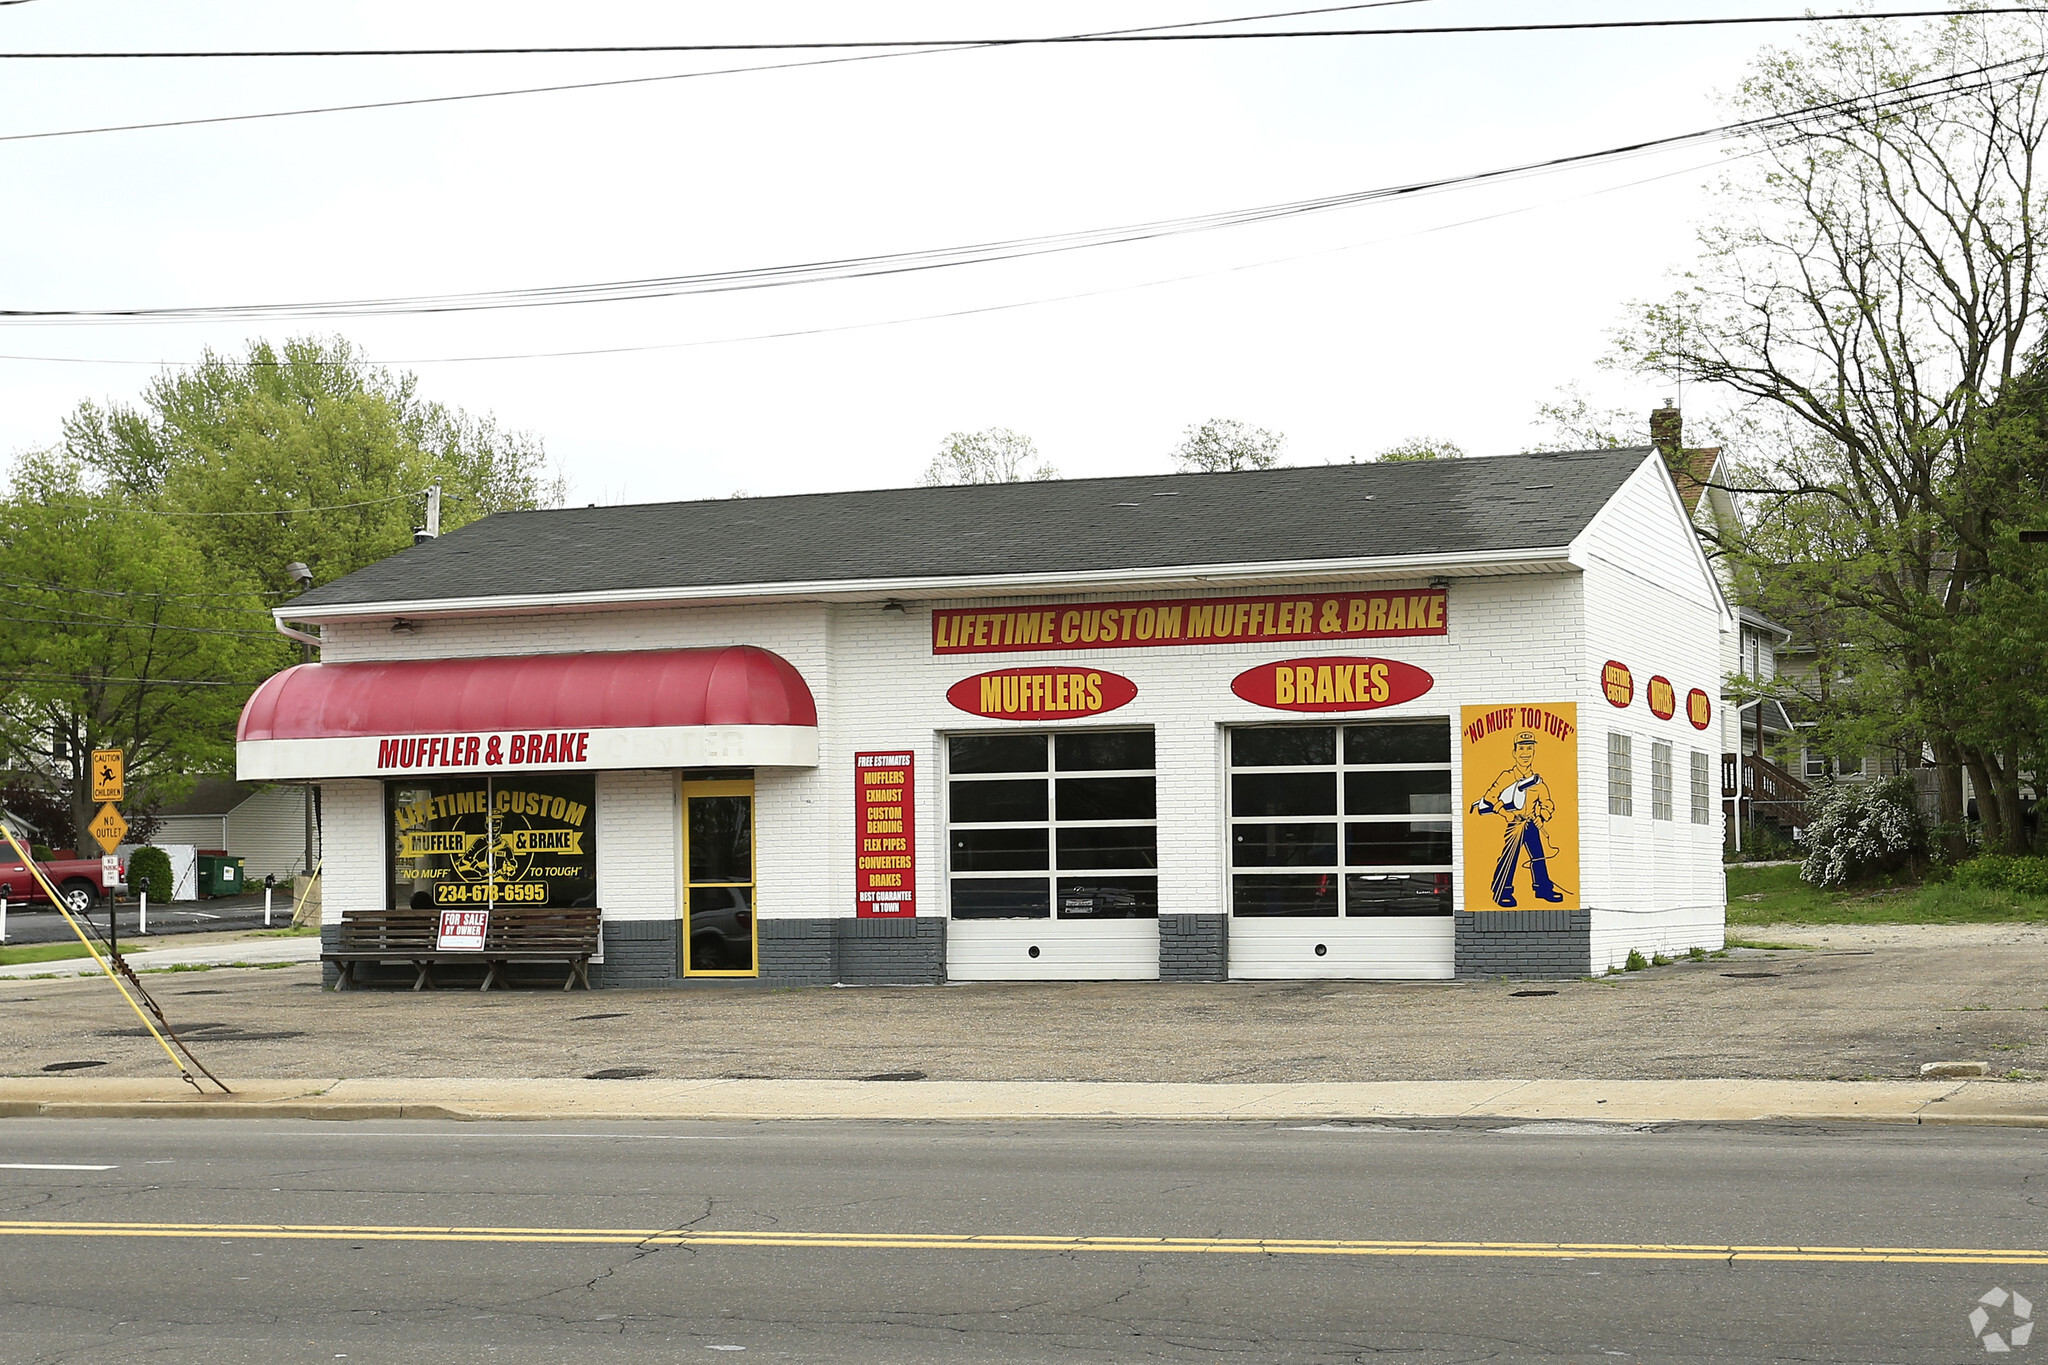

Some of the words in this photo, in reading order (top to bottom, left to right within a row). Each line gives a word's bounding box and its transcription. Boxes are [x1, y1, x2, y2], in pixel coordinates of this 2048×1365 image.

[936, 612, 1055, 648] LIFETIME
[1060, 606, 1183, 643] CUSTOM
[1186, 601, 1314, 638] MUFFLER
[1319, 599, 1342, 634] &
[1347, 595, 1445, 632] BRAKE
[1605, 664, 1630, 688] LIFETIME
[1275, 663, 1390, 705] BRAKES
[980, 673, 1103, 713] MUFFLERS
[1520, 707, 1542, 729] TOO
[377, 736, 481, 769] MUFFLER
[485, 735, 504, 766] &
[508, 732, 590, 764] BRAKE
[94, 754, 121, 763] CAUTION
[857, 756, 874, 767] FREE
[873, 755, 911, 767] ESTIMATES
[863, 771, 905, 785] MUFFLERS
[94, 788, 121, 797] CHILDREN
[866, 789, 902, 802] EXHAUST
[394, 791, 487, 829] LIFETIME
[496, 790, 587, 827] CUSTOM
[867, 807, 902, 820] CUSTOM
[103, 817, 115, 826] NO
[867, 820, 903, 834] BENDING
[96, 827, 122, 838] OUTLET
[411, 834, 464, 851] MUFFLER
[515, 832, 527, 849] &
[529, 831, 571, 848] BRAKE
[864, 838, 882, 852] FLEX
[882, 838, 907, 851] PIPES
[858, 855, 912, 869] CONVERTERS
[530, 867, 544, 877] TO
[869, 873, 902, 887] BRAKES
[859, 891, 876, 902] BEST
[876, 891, 912, 901] GUARANTEE
[872, 903, 880, 913] IN
[880, 902, 900, 912] TOWN
[444, 913, 461, 926] FOR
[463, 913, 485, 926] SALE
[445, 926, 456, 935] BY
[456, 926, 482, 936] OWNER
